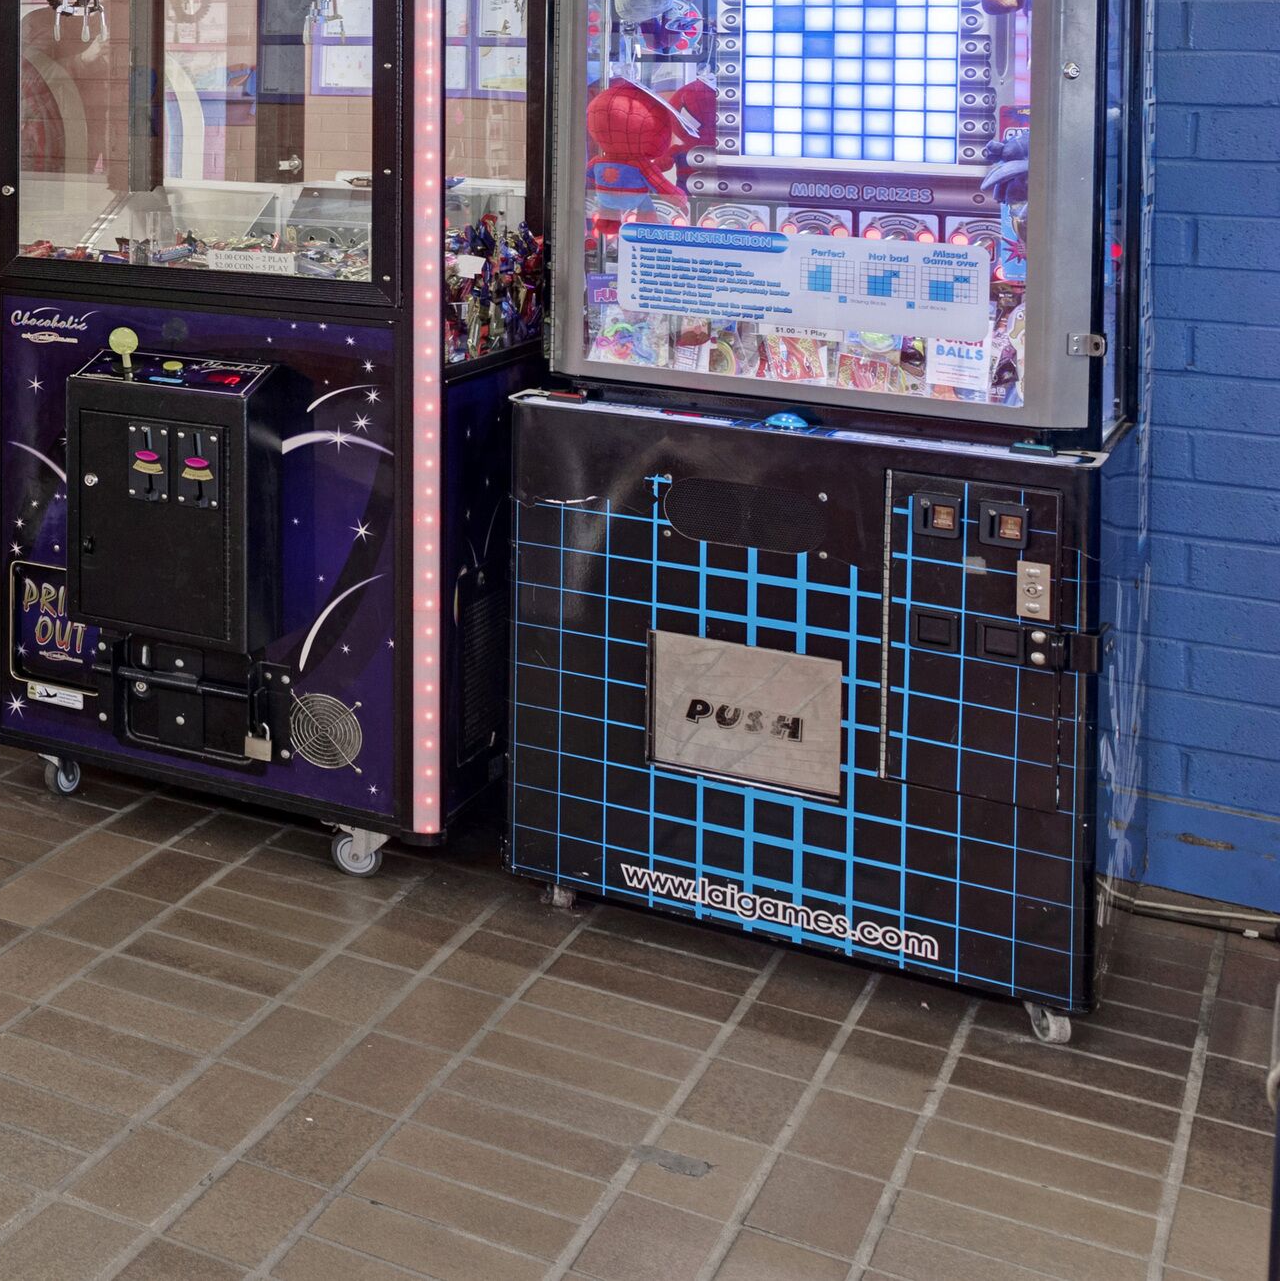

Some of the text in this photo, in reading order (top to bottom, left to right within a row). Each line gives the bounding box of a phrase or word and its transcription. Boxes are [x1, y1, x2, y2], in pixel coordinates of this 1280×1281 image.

[790, 181, 934, 203] MINOR PRIZES
[636, 227, 772, 249] PLAYER INSTRUCTION
[811, 248, 847, 258] Perfect
[868, 253, 909, 263] Not bad
[923, 257, 979, 268] Game over
[933, 250, 968, 259] Missed
[11, 310, 88, 330] Chocoholic
[775, 326, 795, 334] $1.00
[810, 329, 828, 338] Play
[935, 344, 984, 361] BALLS
[23, 578, 66, 618] PRI
[35, 615, 87, 654] OUT
[685, 698, 804, 743] PUSH
[620, 863, 938, 960] www.laigames.com
